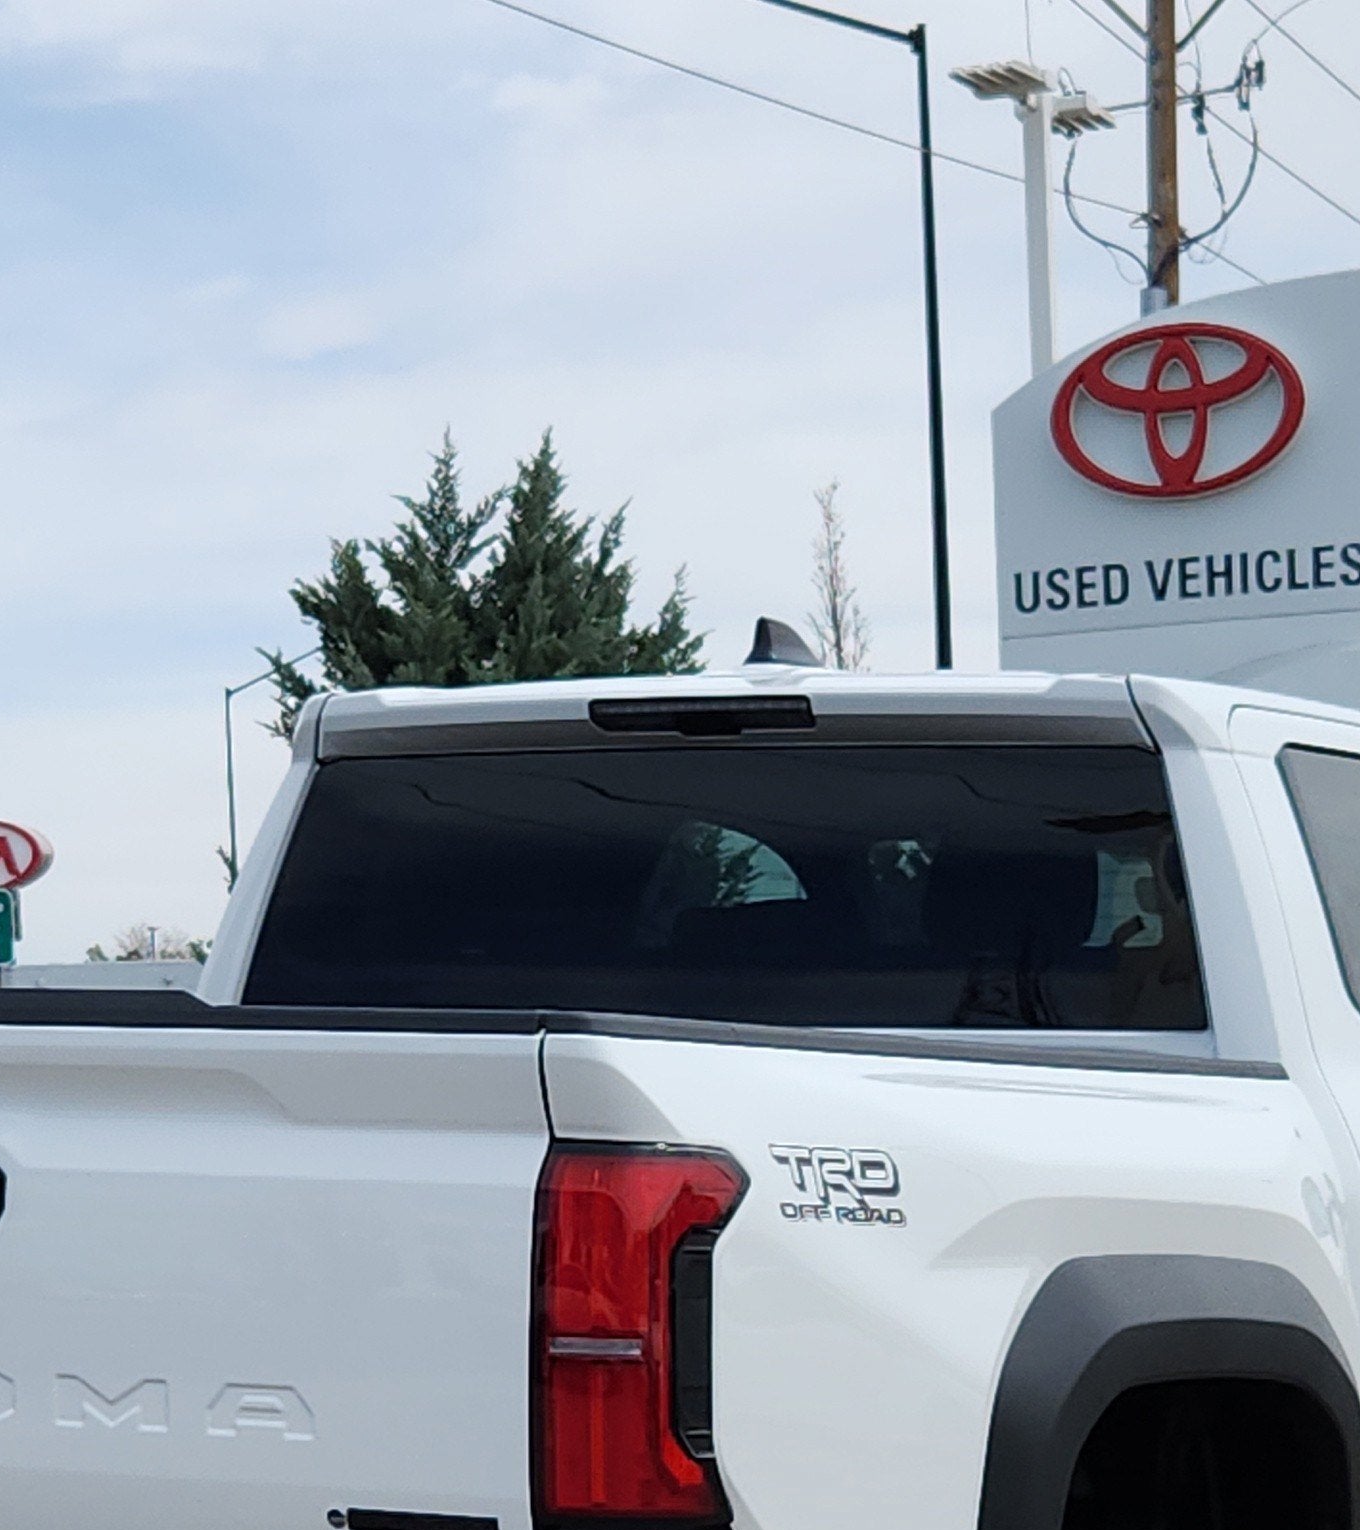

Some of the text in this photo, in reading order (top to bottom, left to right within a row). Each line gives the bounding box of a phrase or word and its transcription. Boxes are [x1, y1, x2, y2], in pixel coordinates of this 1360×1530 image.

[1013, 563, 1130, 613] USED
[768, 1143, 900, 1207] TRD
[780, 1203, 906, 1227] OFF ROAD
